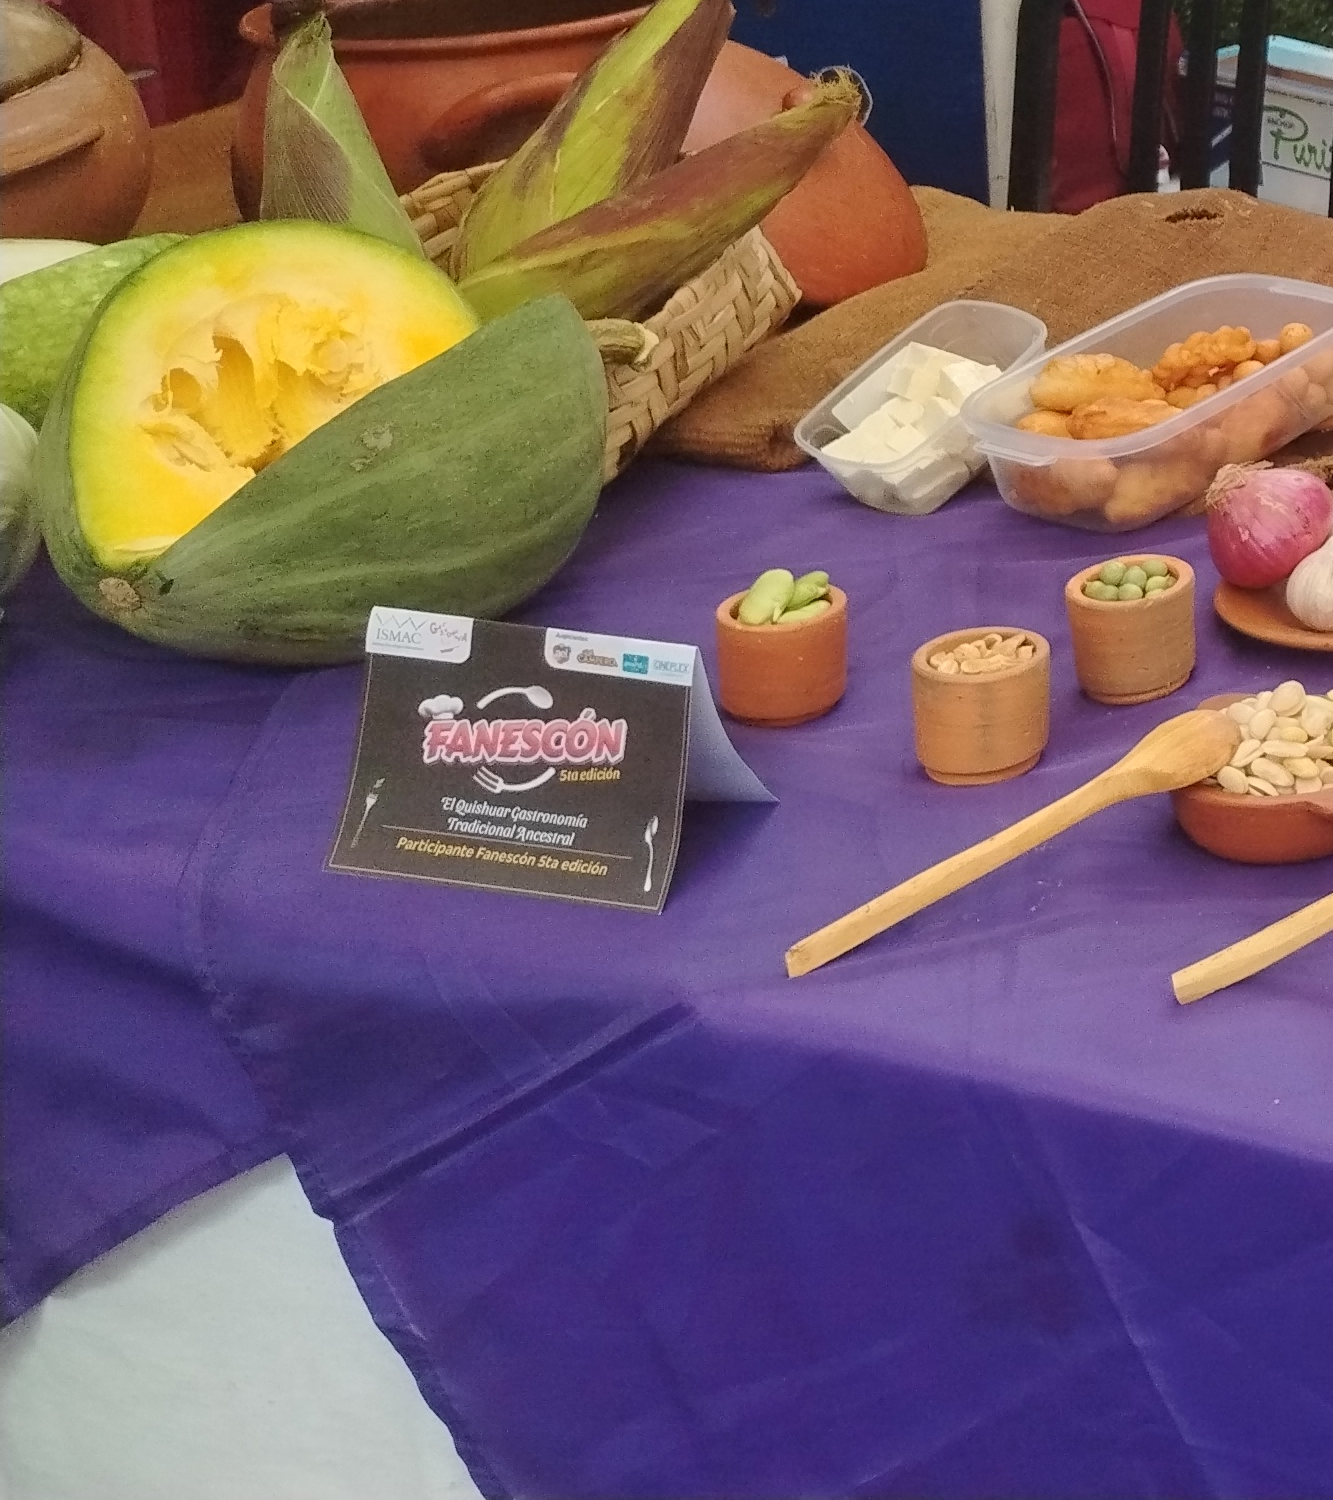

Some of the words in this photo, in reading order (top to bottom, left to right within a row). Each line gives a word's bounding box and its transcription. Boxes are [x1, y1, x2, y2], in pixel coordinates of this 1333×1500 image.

[376, 627, 422, 645] ISMAC
[424, 707, 628, 764] FANESCÓN
[559, 769, 579, 782] 5ta
[580, 766, 621, 780] edición
[441, 797, 456, 811] El
[456, 799, 511, 818] Quishuar
[511, 805, 589, 828] Gastronomía
[447, 817, 516, 839] Tradicional
[516, 826, 576, 846] Ancestral
[396, 836, 474, 858] Participante
[475, 847, 537, 867] Fanescón
[537, 853, 558, 870] 5ta
[561, 858, 608, 876] edición
